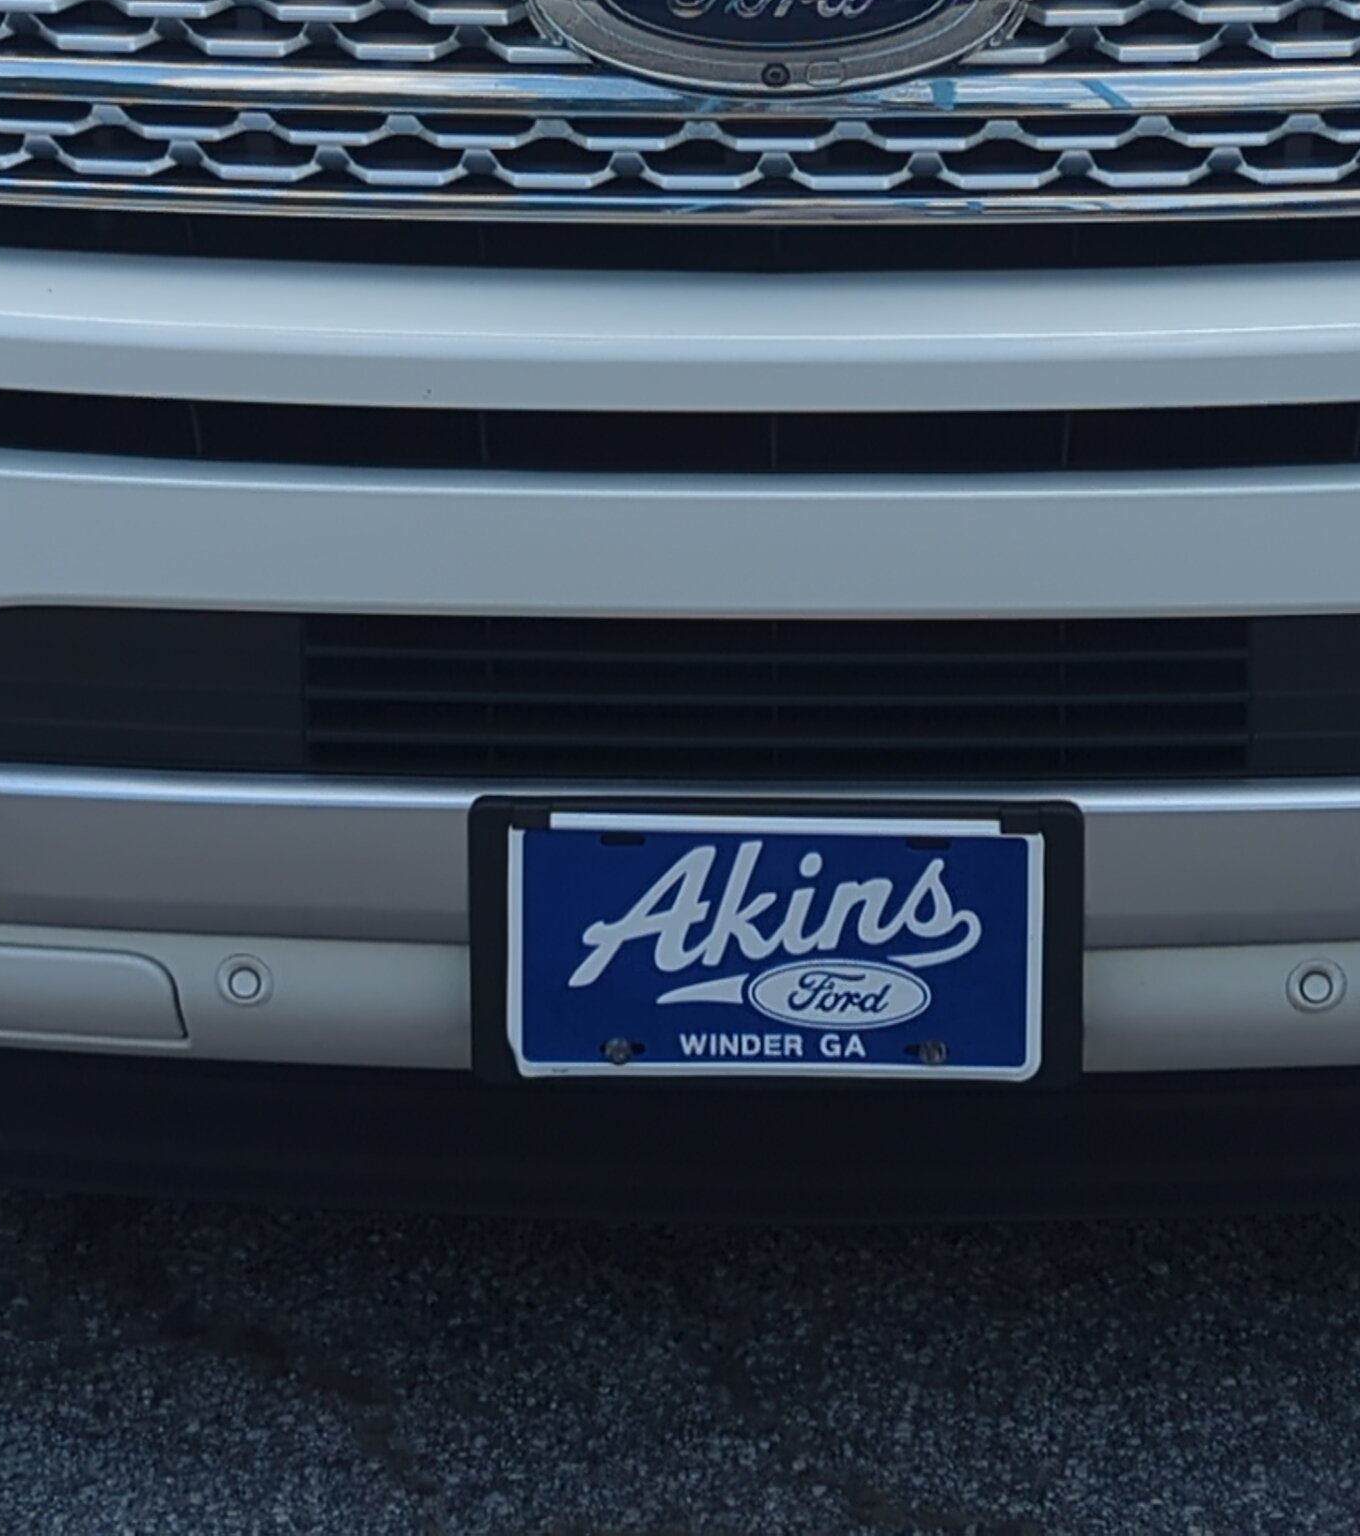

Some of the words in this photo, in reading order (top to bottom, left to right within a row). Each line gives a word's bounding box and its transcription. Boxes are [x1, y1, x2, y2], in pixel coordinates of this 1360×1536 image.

[568, 840, 982, 987] Akins
[787, 969, 892, 1015] Ford
[679, 1032, 803, 1058] WINDER
[819, 1033, 867, 1059] GA
